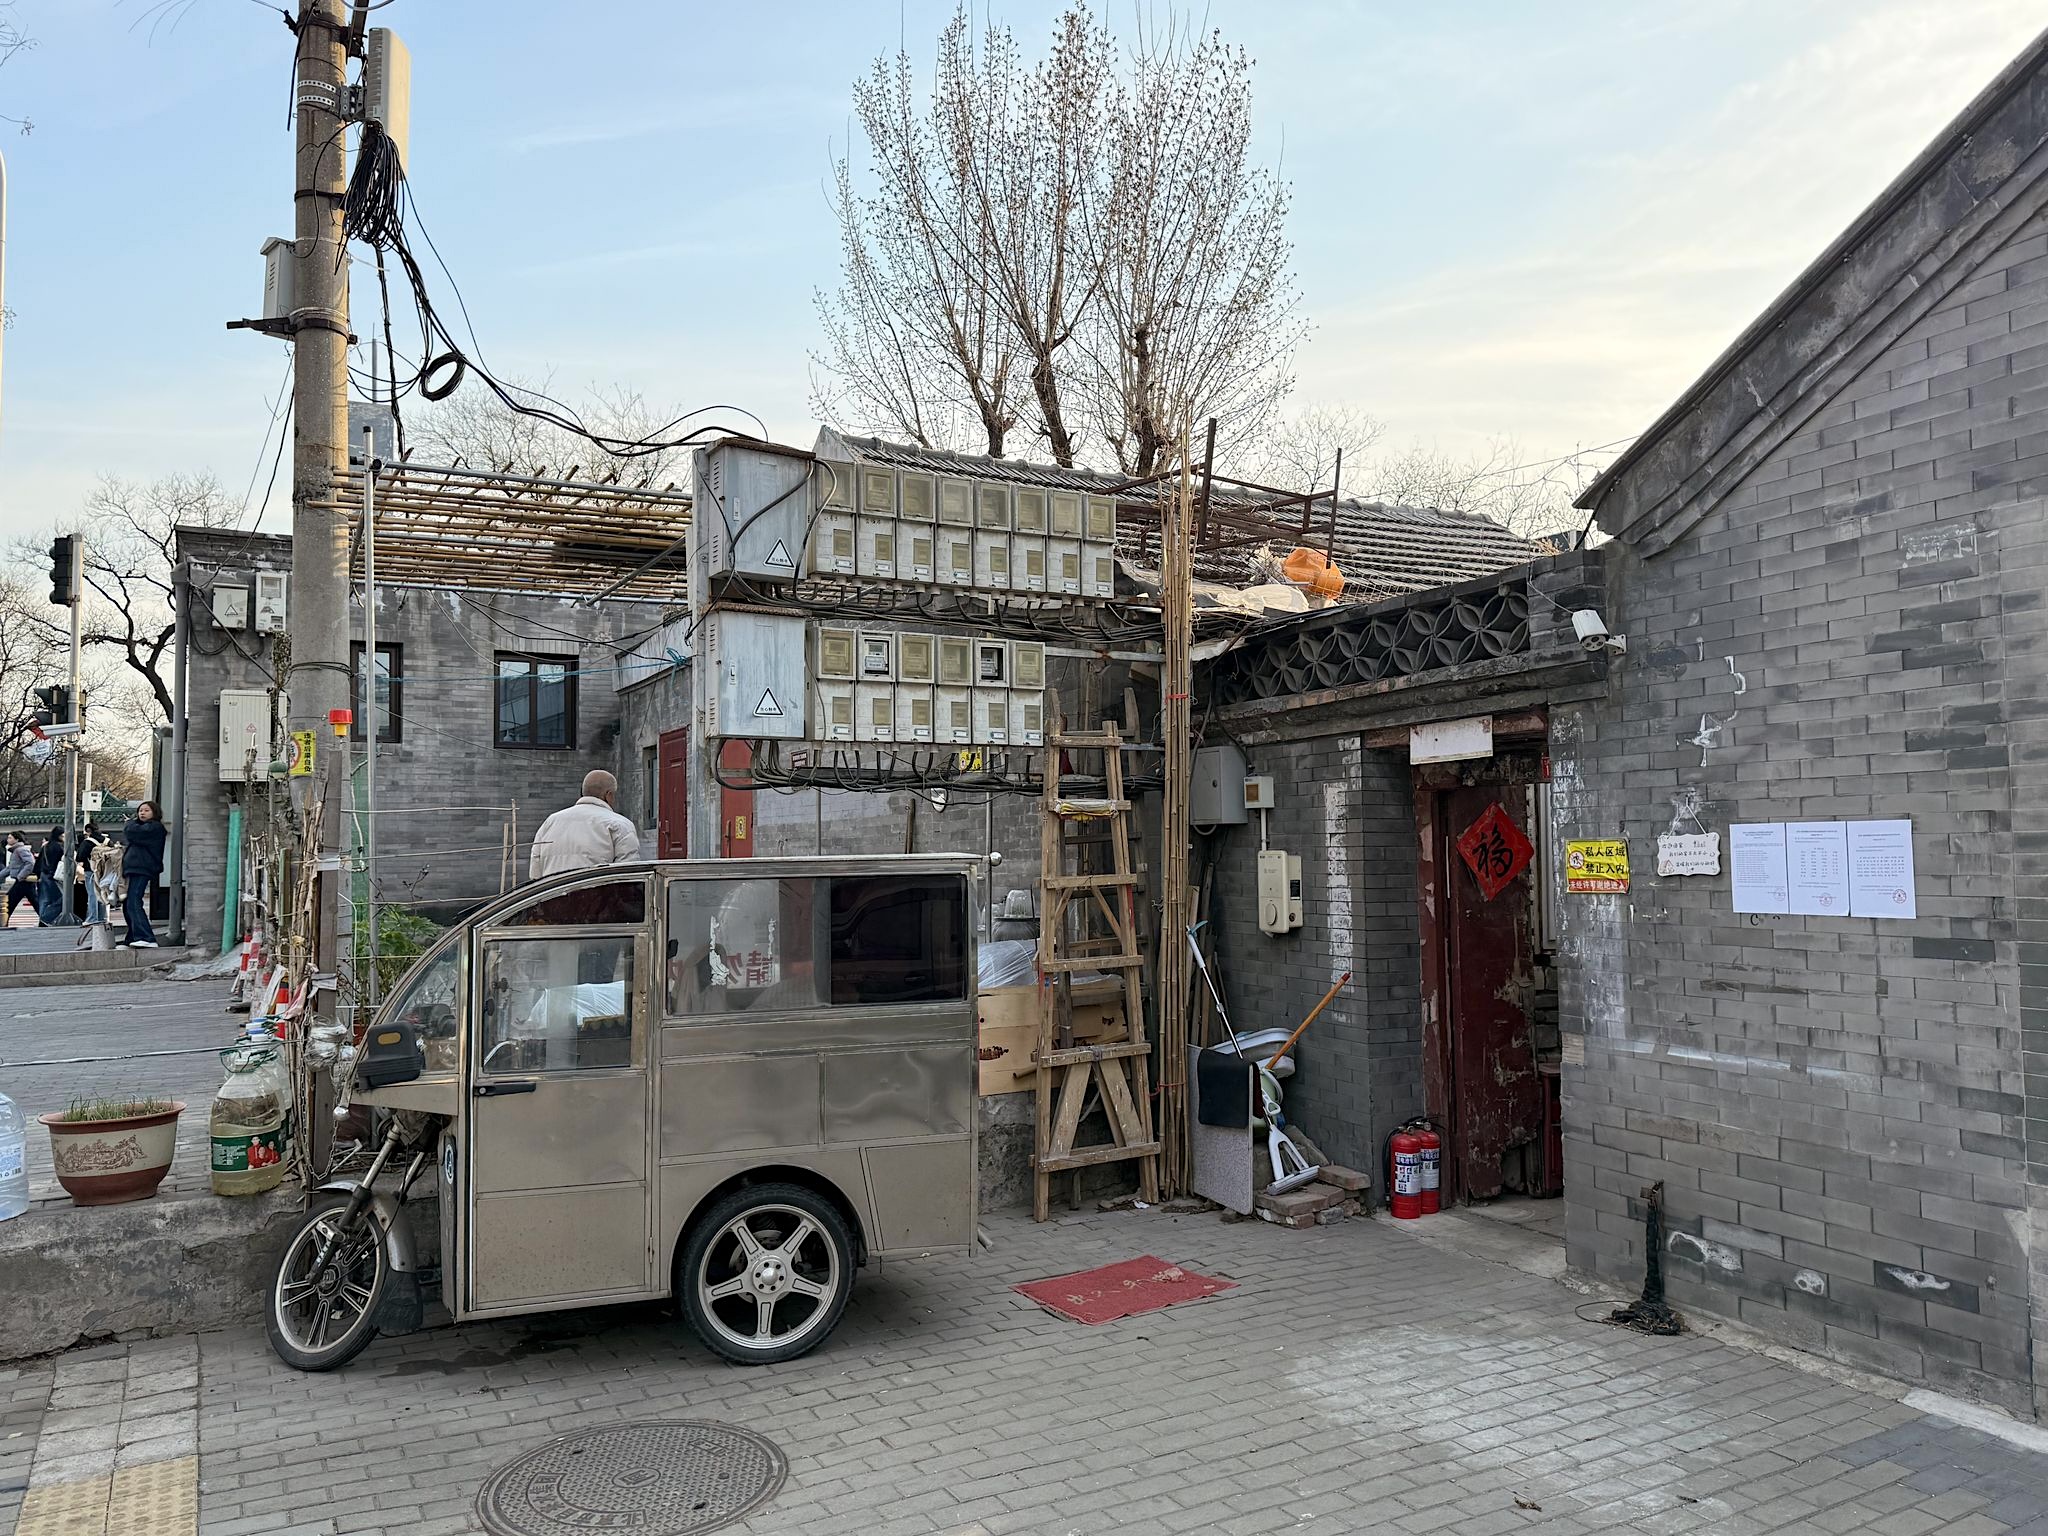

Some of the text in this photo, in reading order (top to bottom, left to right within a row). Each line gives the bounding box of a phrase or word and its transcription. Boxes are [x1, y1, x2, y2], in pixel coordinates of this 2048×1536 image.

[1472, 823, 1513, 878] 福
[1585, 846, 1625, 857] 私人区域
[1586, 863, 1625, 874] 禁止入内
